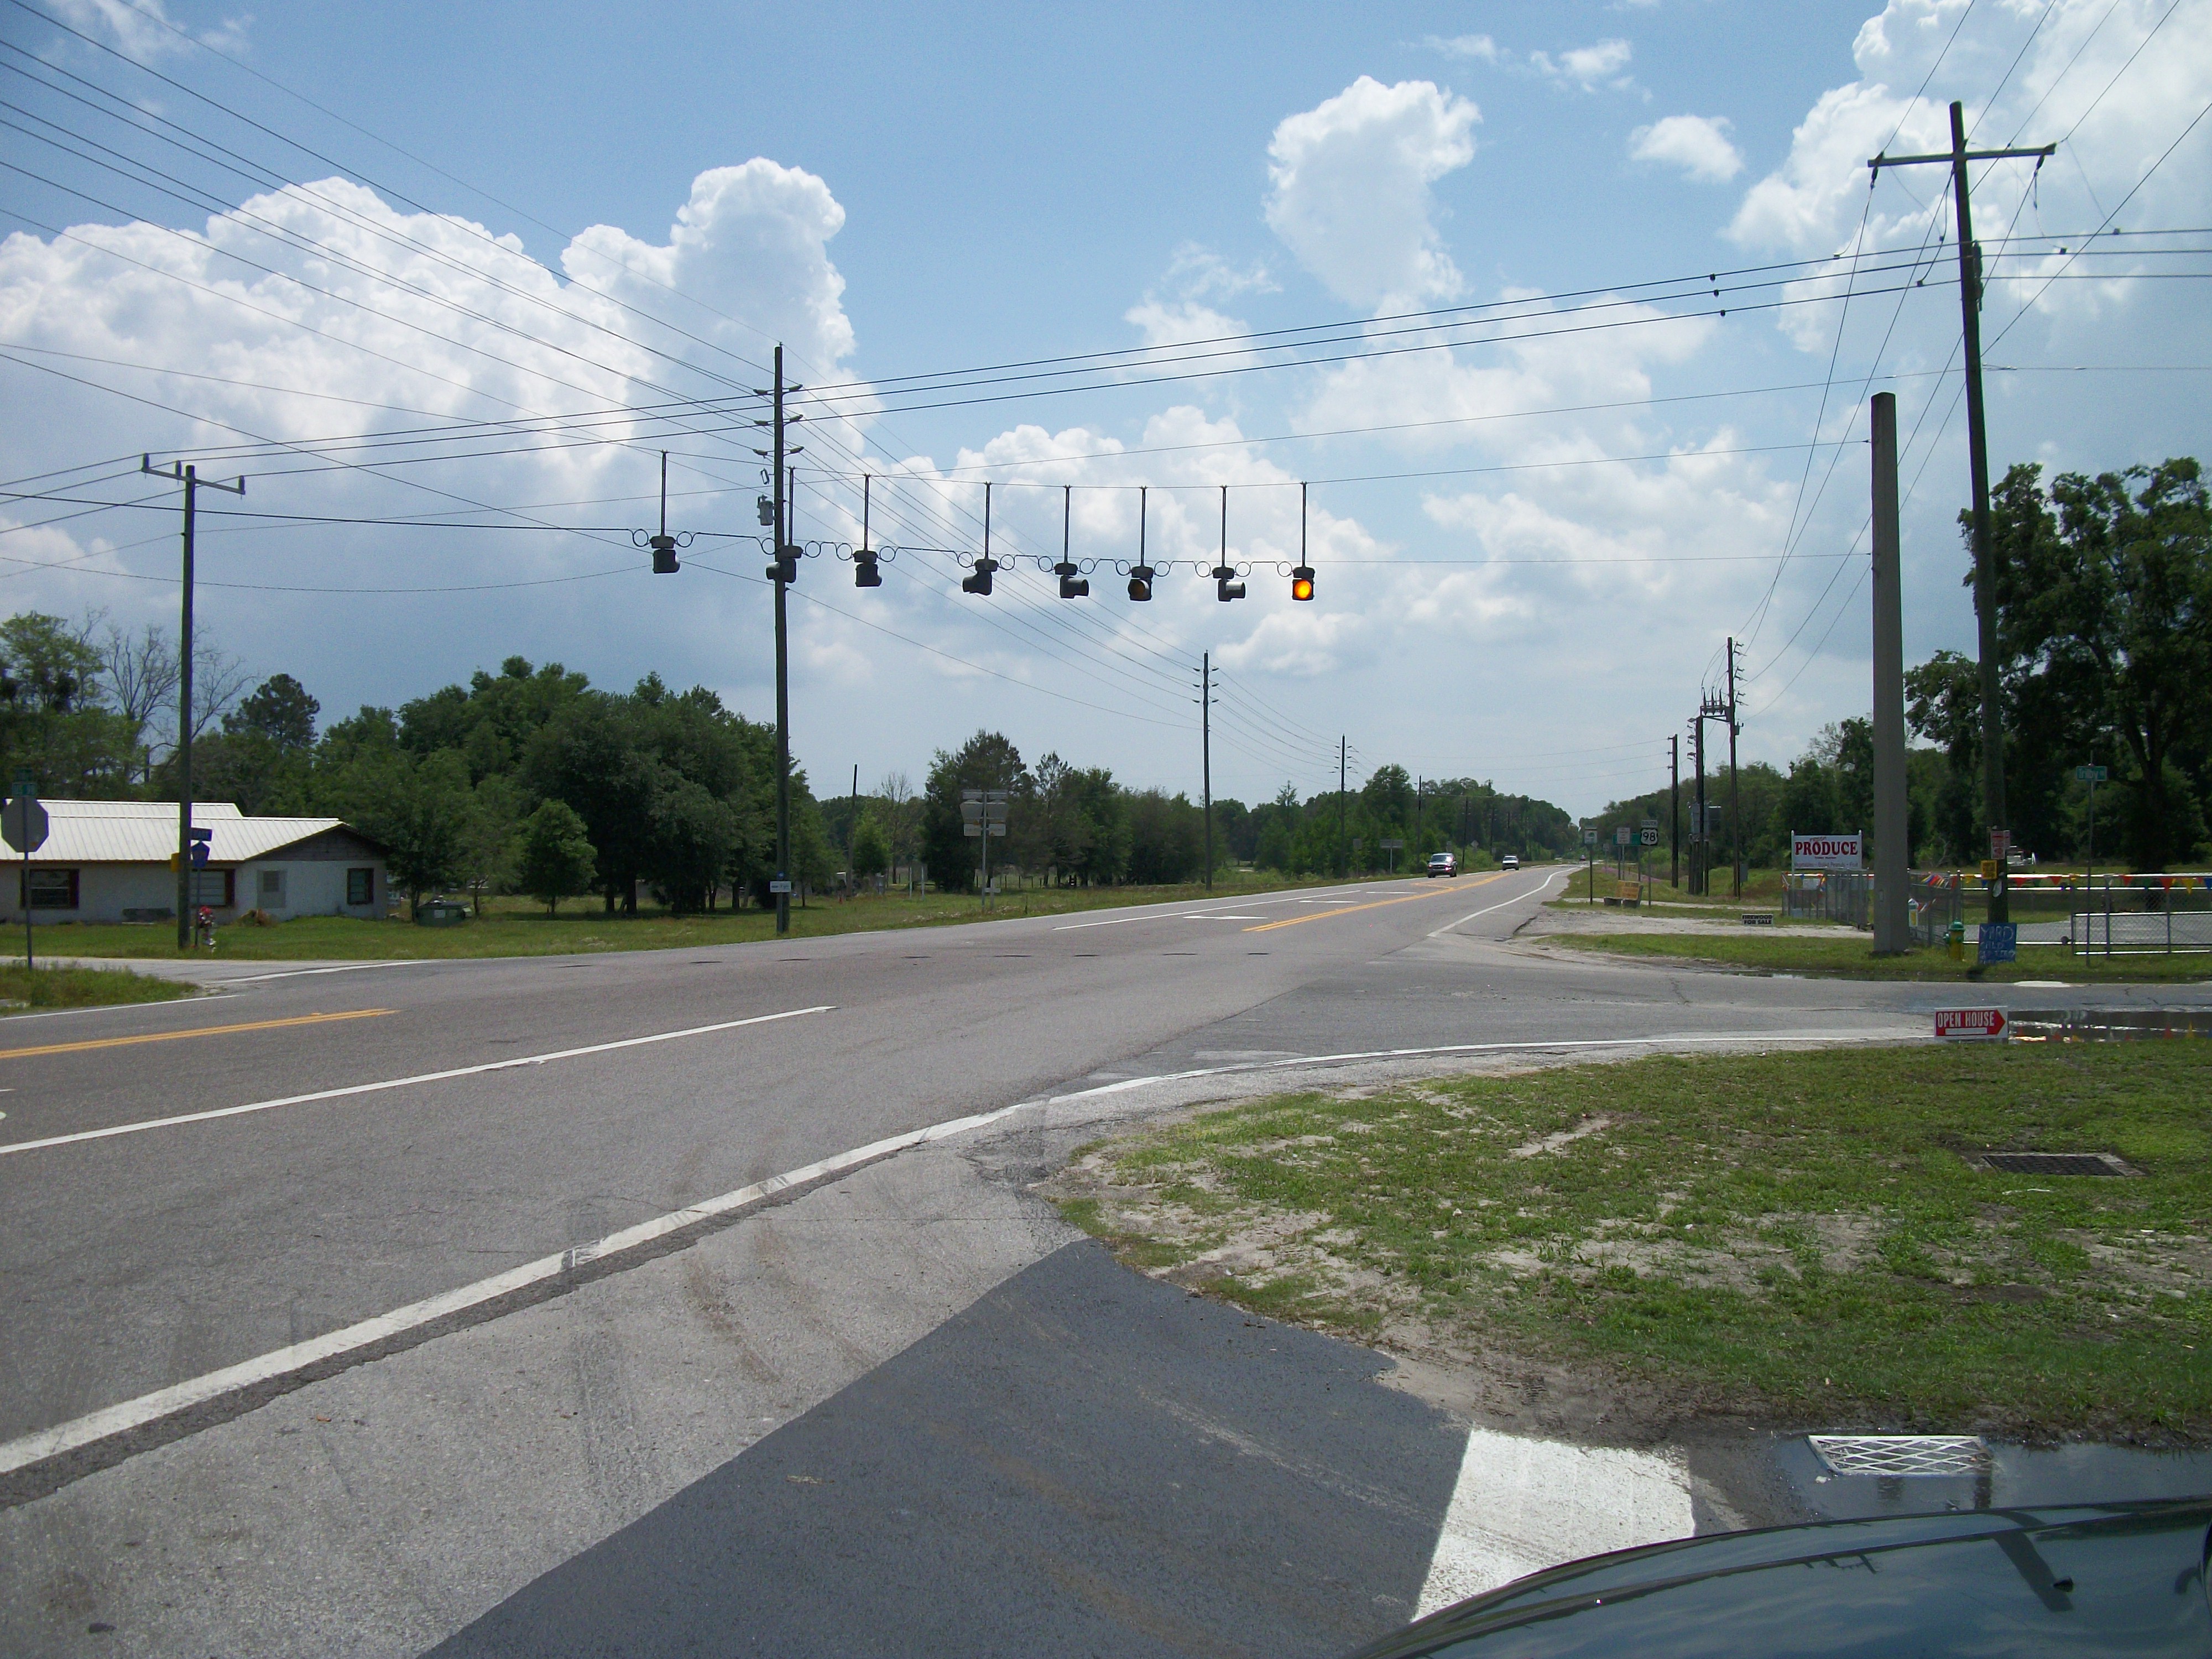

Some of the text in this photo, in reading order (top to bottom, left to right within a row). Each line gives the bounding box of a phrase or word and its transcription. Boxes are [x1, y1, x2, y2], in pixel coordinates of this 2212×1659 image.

[1643, 832, 1656, 841] 98
[1794, 841, 1858, 855] PRODUCE
[1980, 926, 2014, 941] YARD
[1937, 1011, 1995, 1027] OPEN HOUSE
